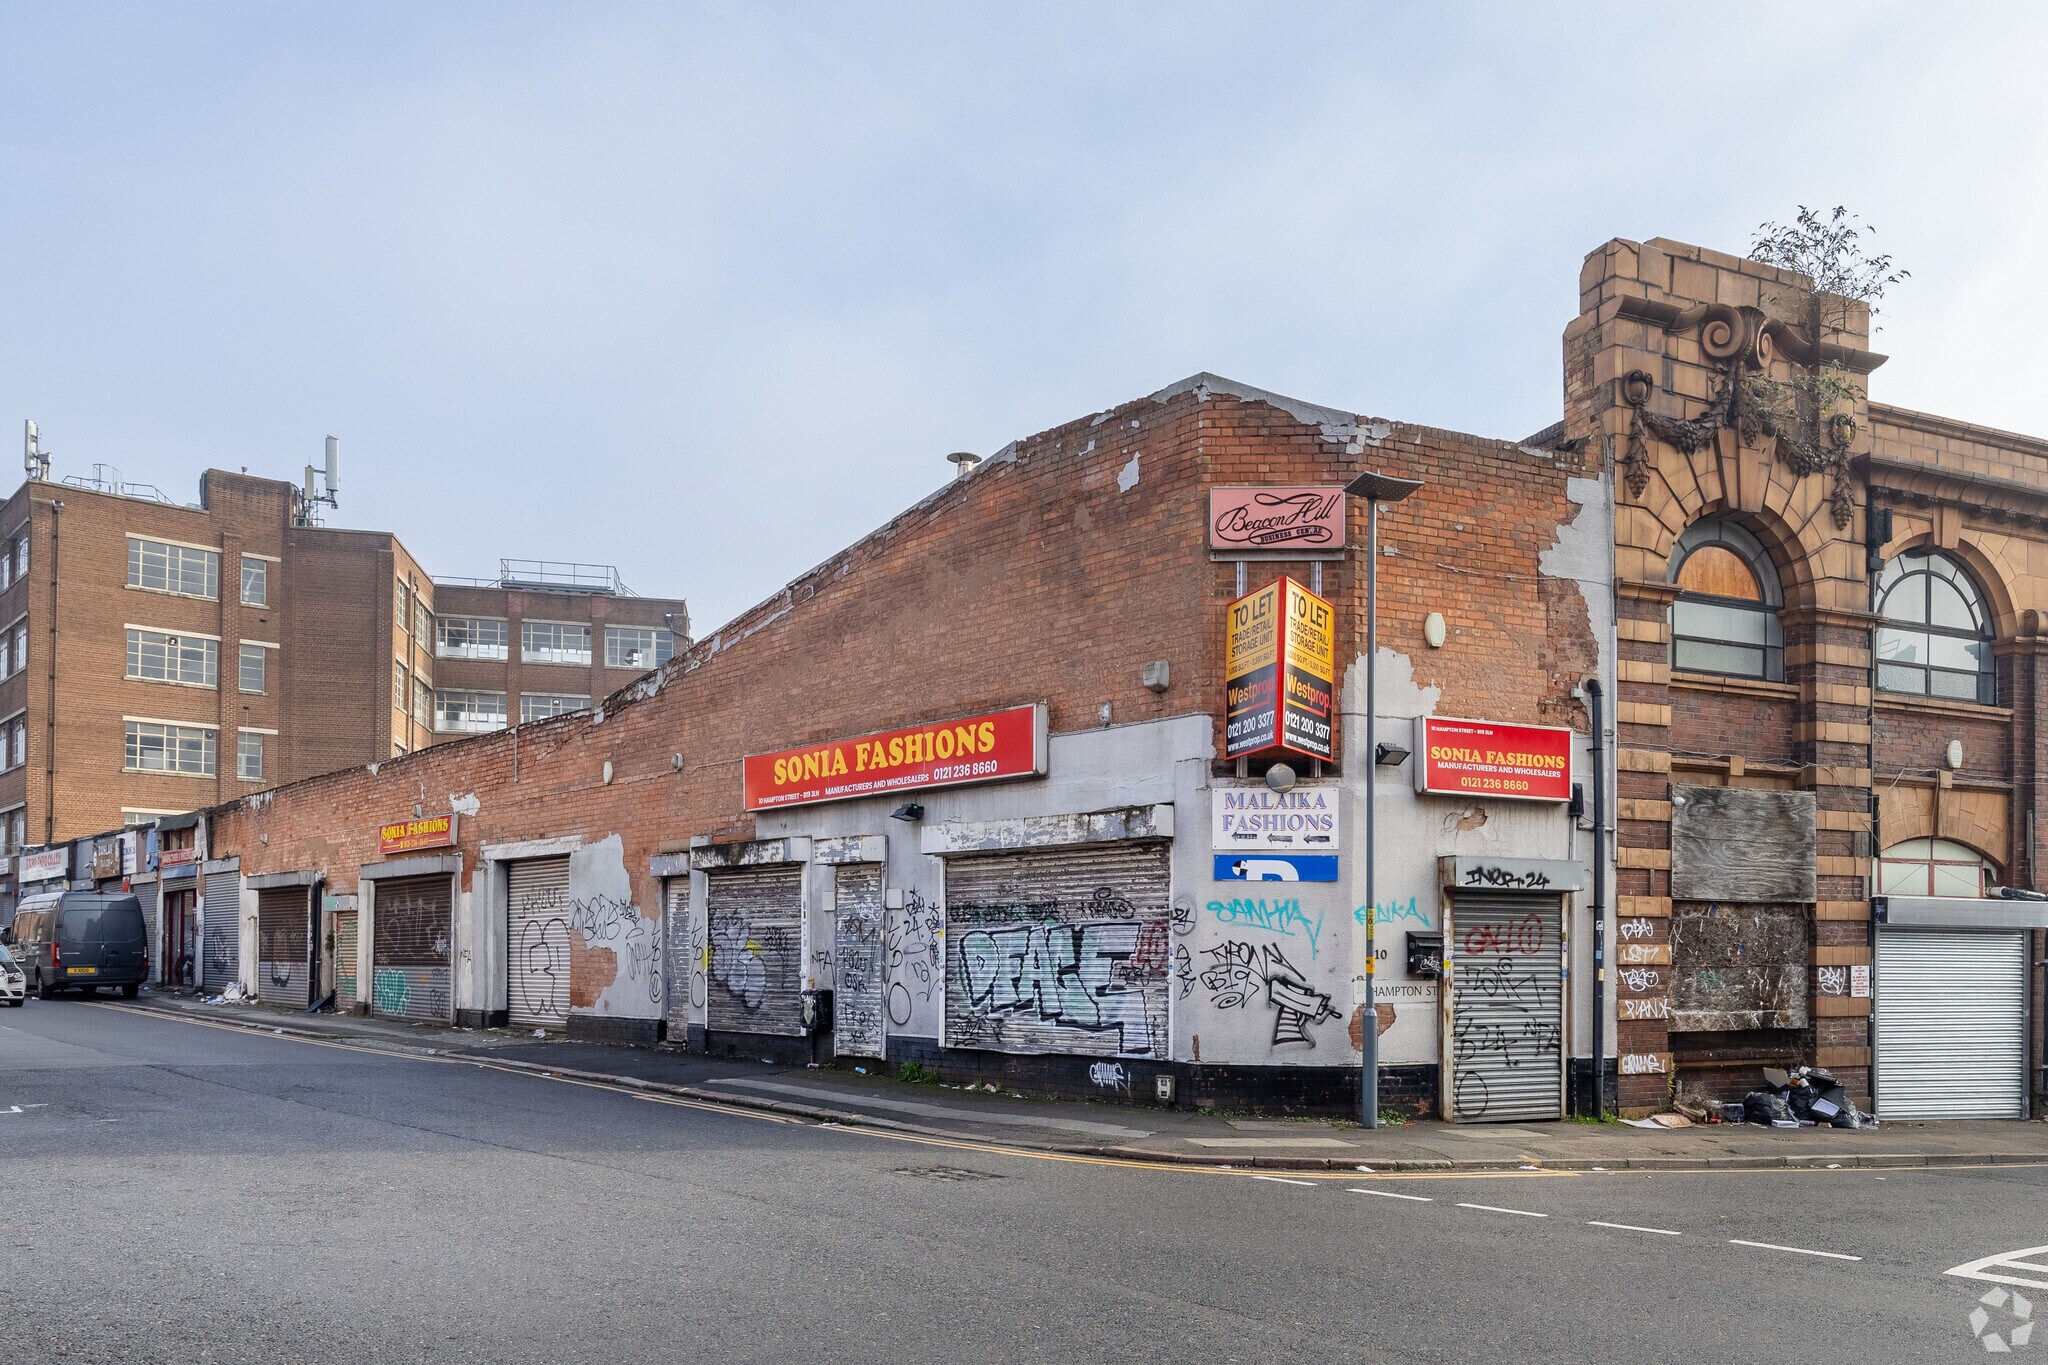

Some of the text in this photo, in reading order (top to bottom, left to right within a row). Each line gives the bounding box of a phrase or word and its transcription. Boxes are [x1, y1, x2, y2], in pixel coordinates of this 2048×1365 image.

[1215, 493, 1341, 540] Beacon Hill
[1260, 530, 1292, 543] BUSINESS
[1234, 591, 1274, 629] TO LET
[1292, 591, 1329, 630] TO LET
[1232, 616, 1275, 645] TRADE/RETAIL/
[1290, 616, 1330, 646] TRADE/RETAIL/
[1231, 630, 1274, 658] STORAGE UNIT
[1290, 630, 1329, 659] STORAGE UNIT
[1286, 672, 1331, 710] Westprop.
[1227, 710, 1275, 739] 0121 200 3377
[1285, 710, 1330, 740] 0121 200 3377
[1227, 730, 1274, 752] www.westprop.co.uk
[1285, 731, 1330, 753] www.westprop.co.uk
[773, 721, 996, 786] SONIA FASHIONS
[1430, 746, 1566, 769] SONIA FASHIONS
[933, 759, 997, 781] 0121 236 8660
[1437, 761, 1561, 778] MANUFACTURERS AND WHOLESALERS
[824, 773, 929, 796] MANUFACTURERS AND WHOLESALERS
[1461, 776, 1529, 791] 0121 236 8660
[764, 794, 785, 804] HAMPTON
[784, 792, 801, 801] STREET
[1224, 792, 1327, 810] MALAIKA
[381, 818, 449, 840] SONIA FASHIONS
[1221, 813, 1334, 832] FASHIONS
[1375, 949, 1388, 960] 10
[1374, 986, 1422, 997] HAMPTON
